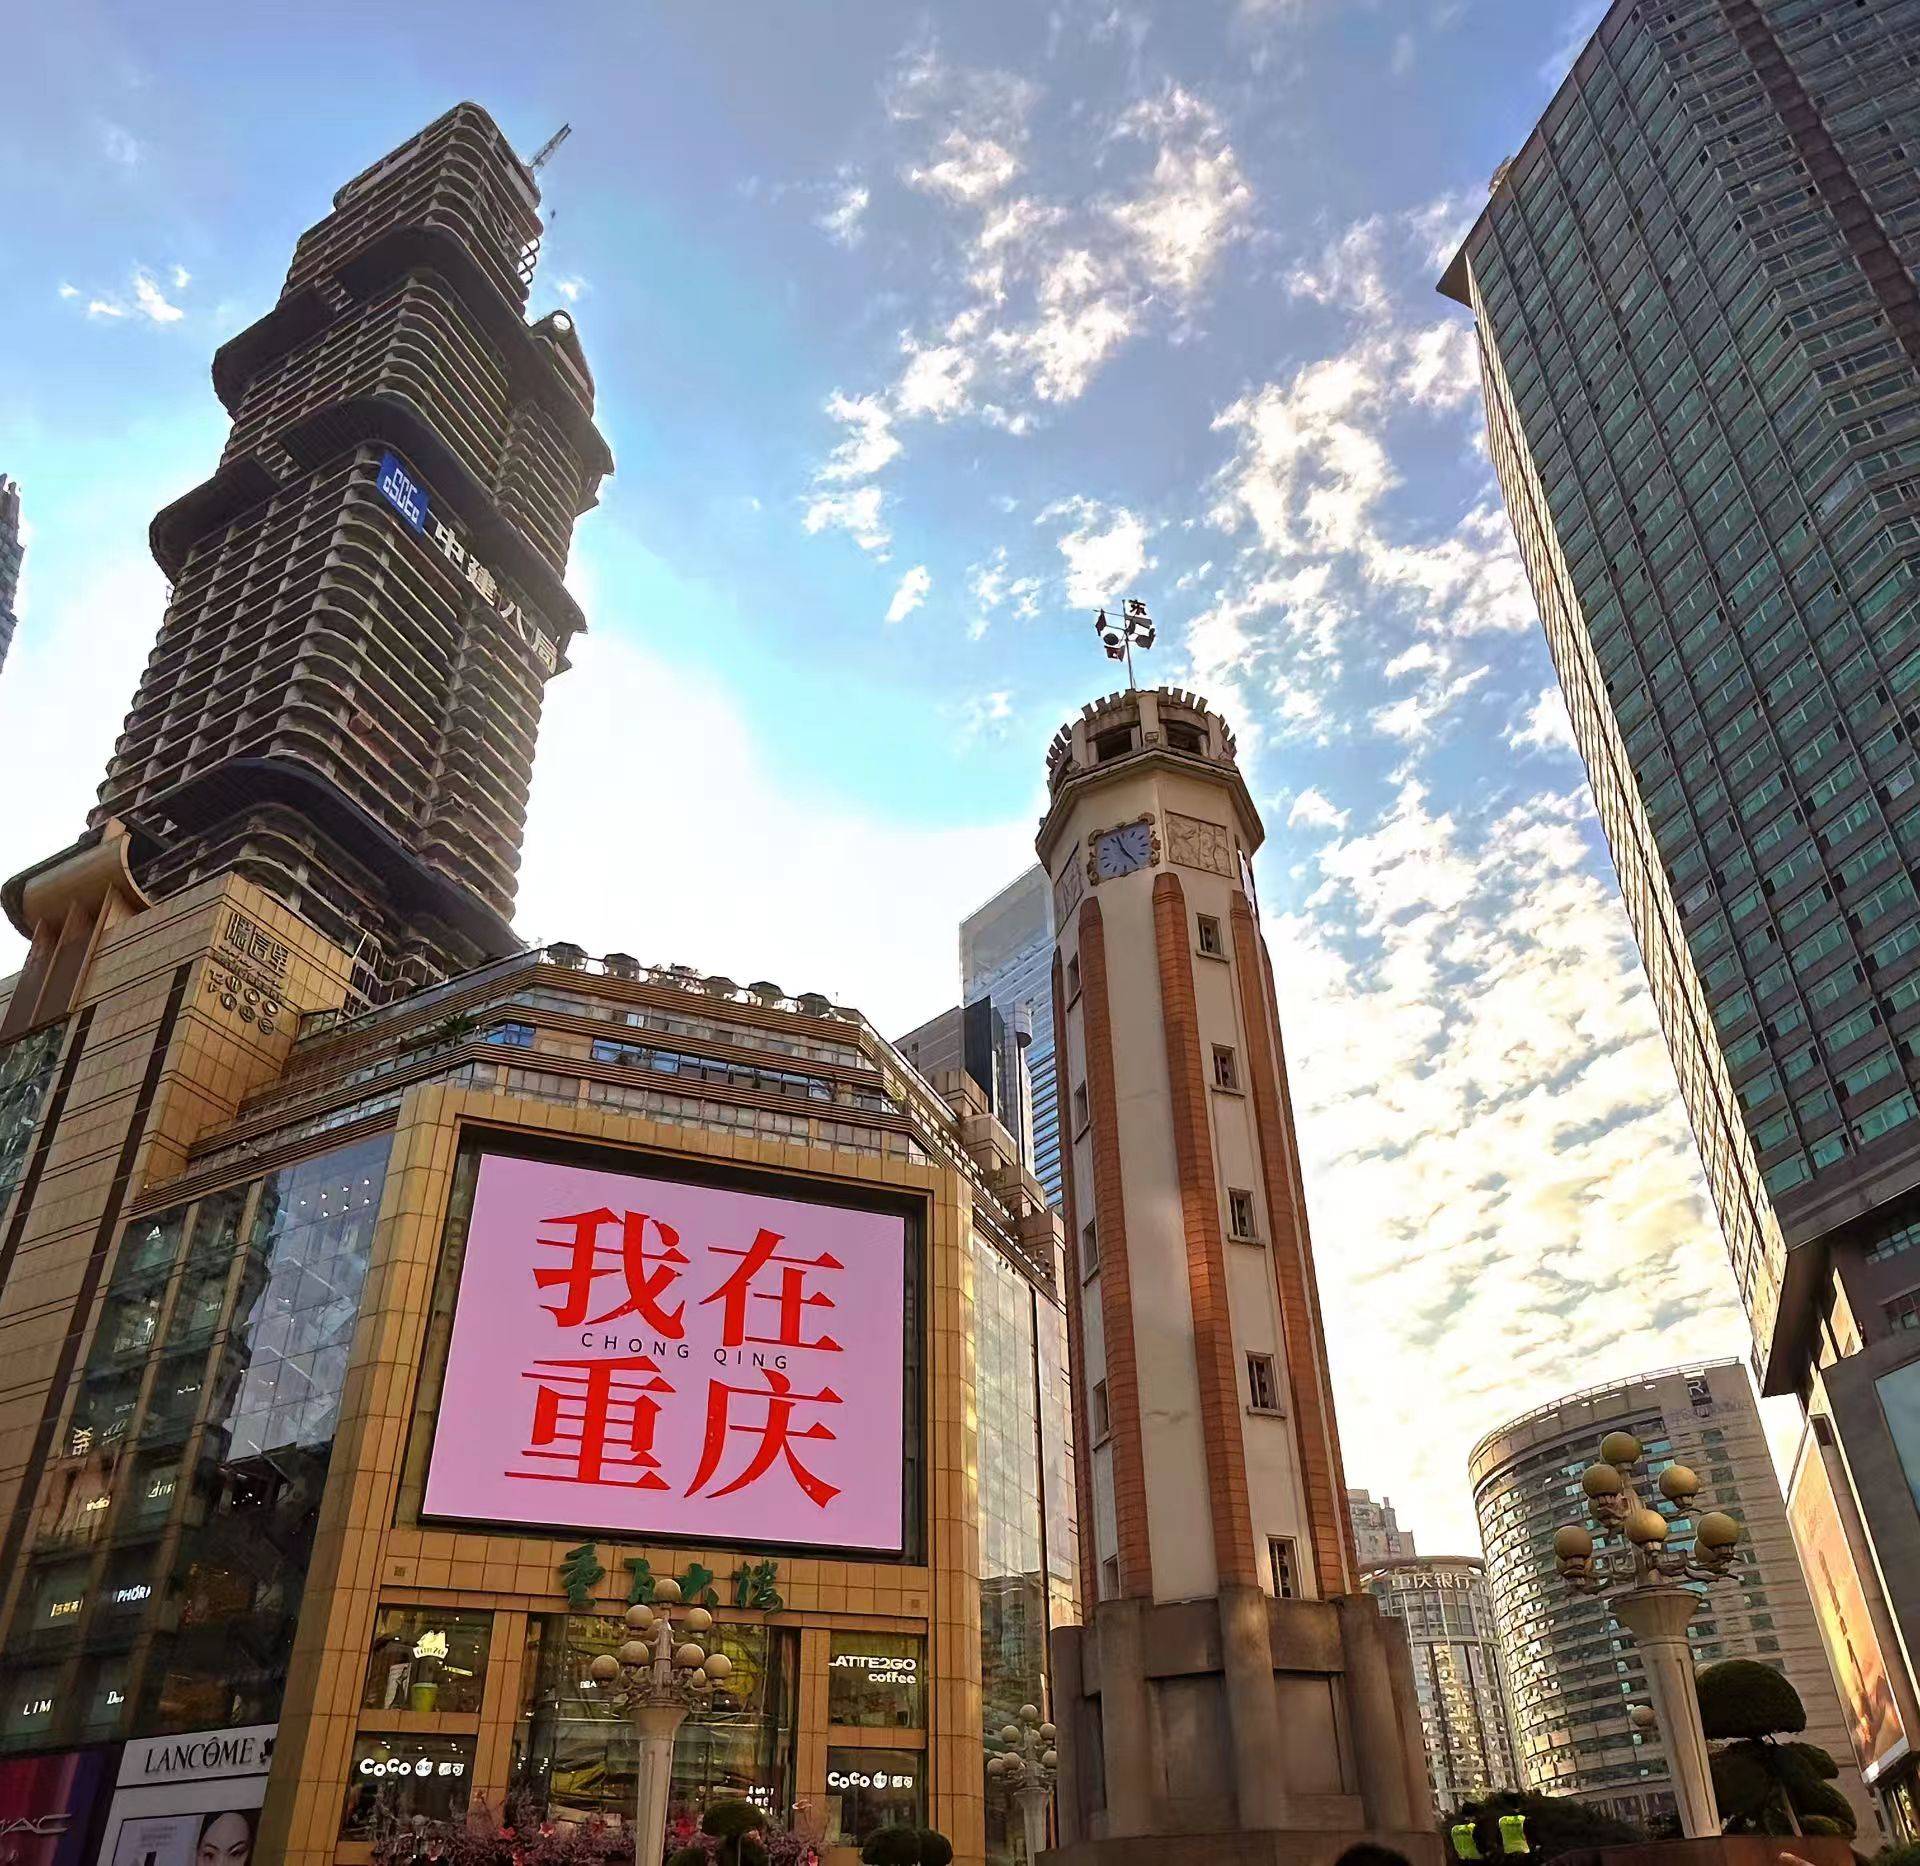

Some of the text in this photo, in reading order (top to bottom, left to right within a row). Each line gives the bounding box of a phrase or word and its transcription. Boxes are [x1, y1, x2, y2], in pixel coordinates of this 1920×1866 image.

[434, 521, 557, 674] 中建八局
[532, 1206, 845, 1352] 我在
[581, 1331, 788, 1370] CHONG QING
[504, 1355, 845, 1509] 重庆
[868, 1671, 917, 1684] coffee
[144, 1736, 255, 1774] LANCÔME
